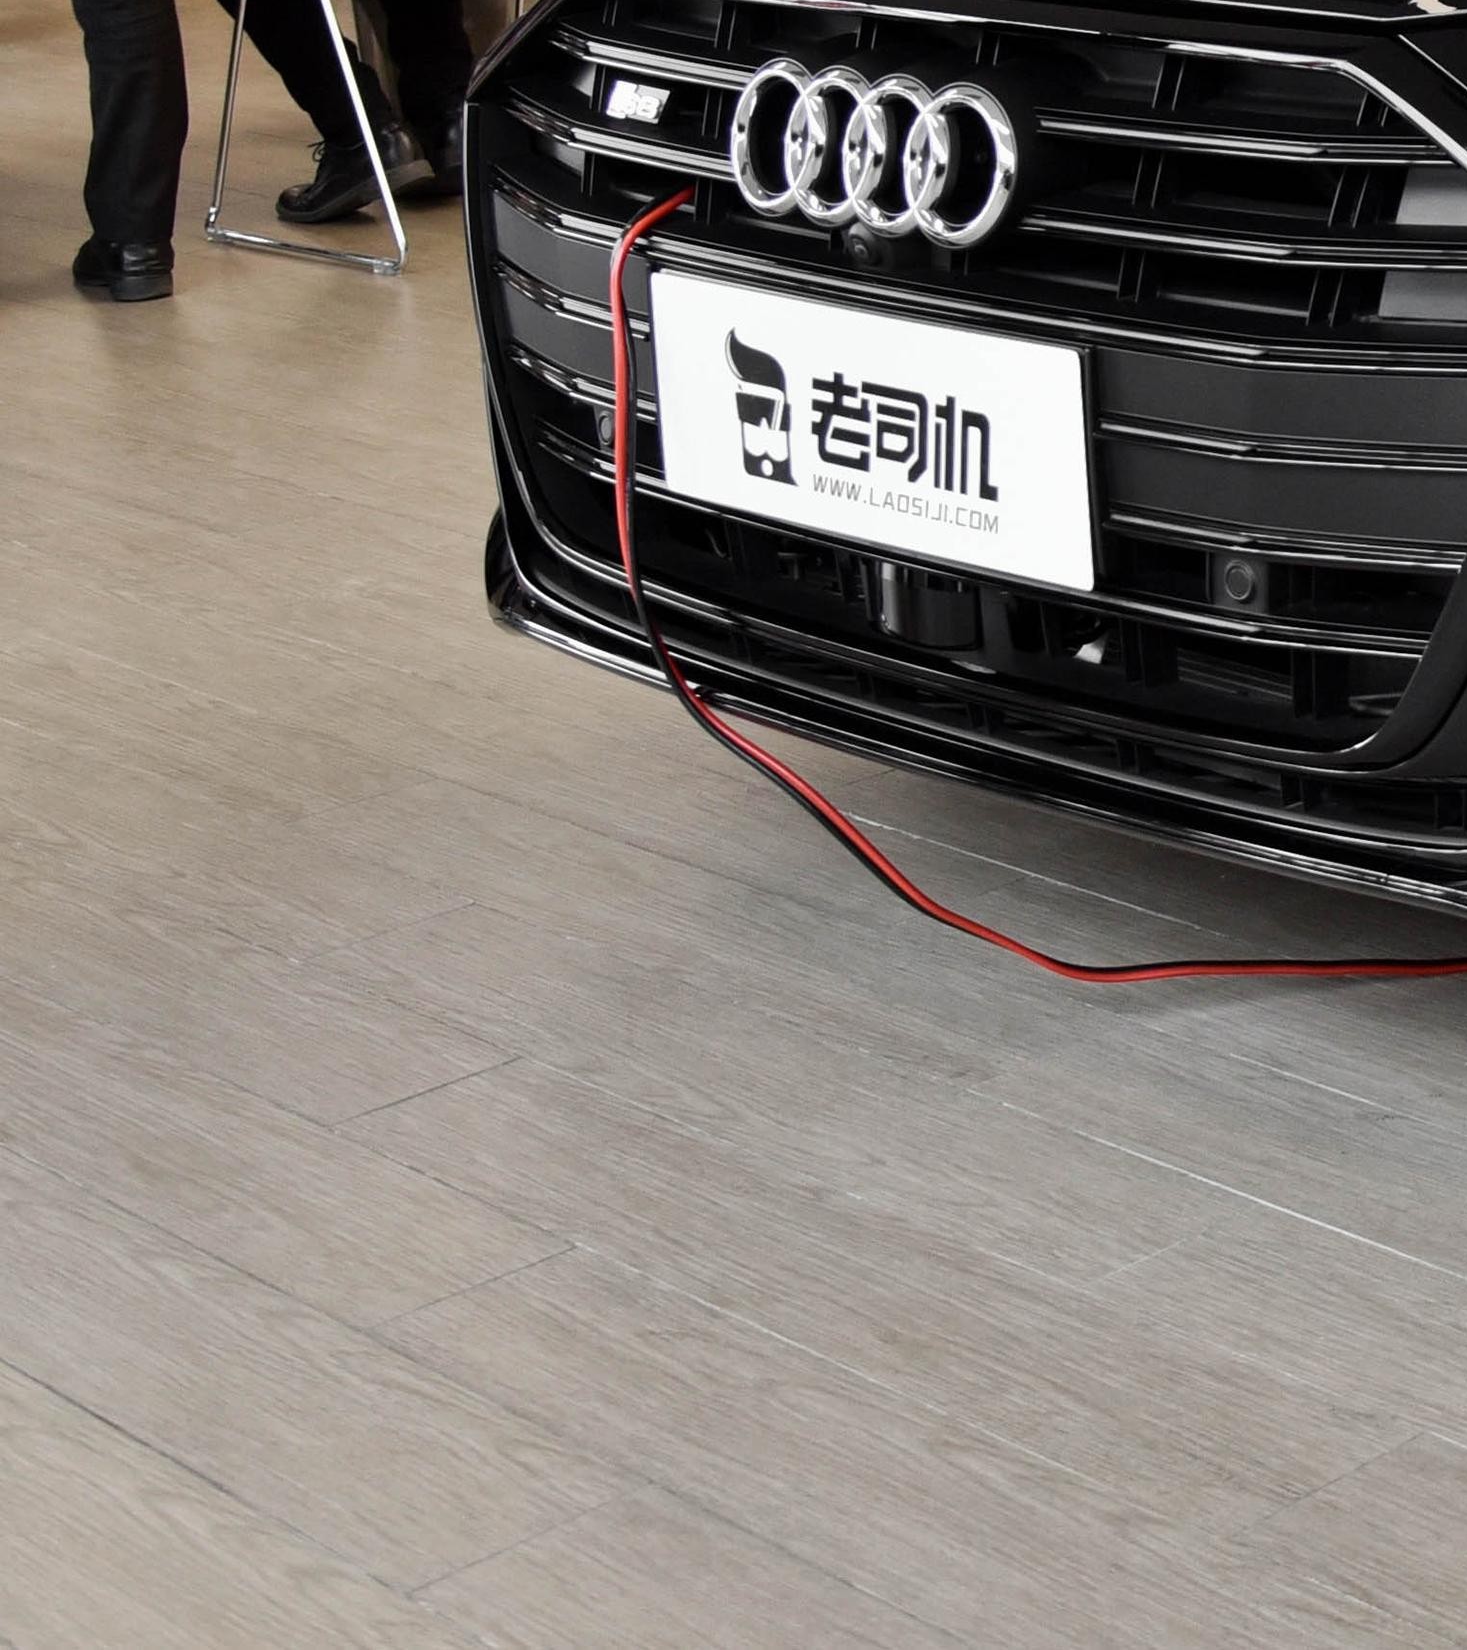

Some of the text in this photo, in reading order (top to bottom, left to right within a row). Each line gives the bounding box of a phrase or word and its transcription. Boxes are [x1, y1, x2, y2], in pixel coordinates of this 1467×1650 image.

[810, 371, 999, 502] 老司机
[812, 473, 999, 534] WWW.LAOSIJI.COM
